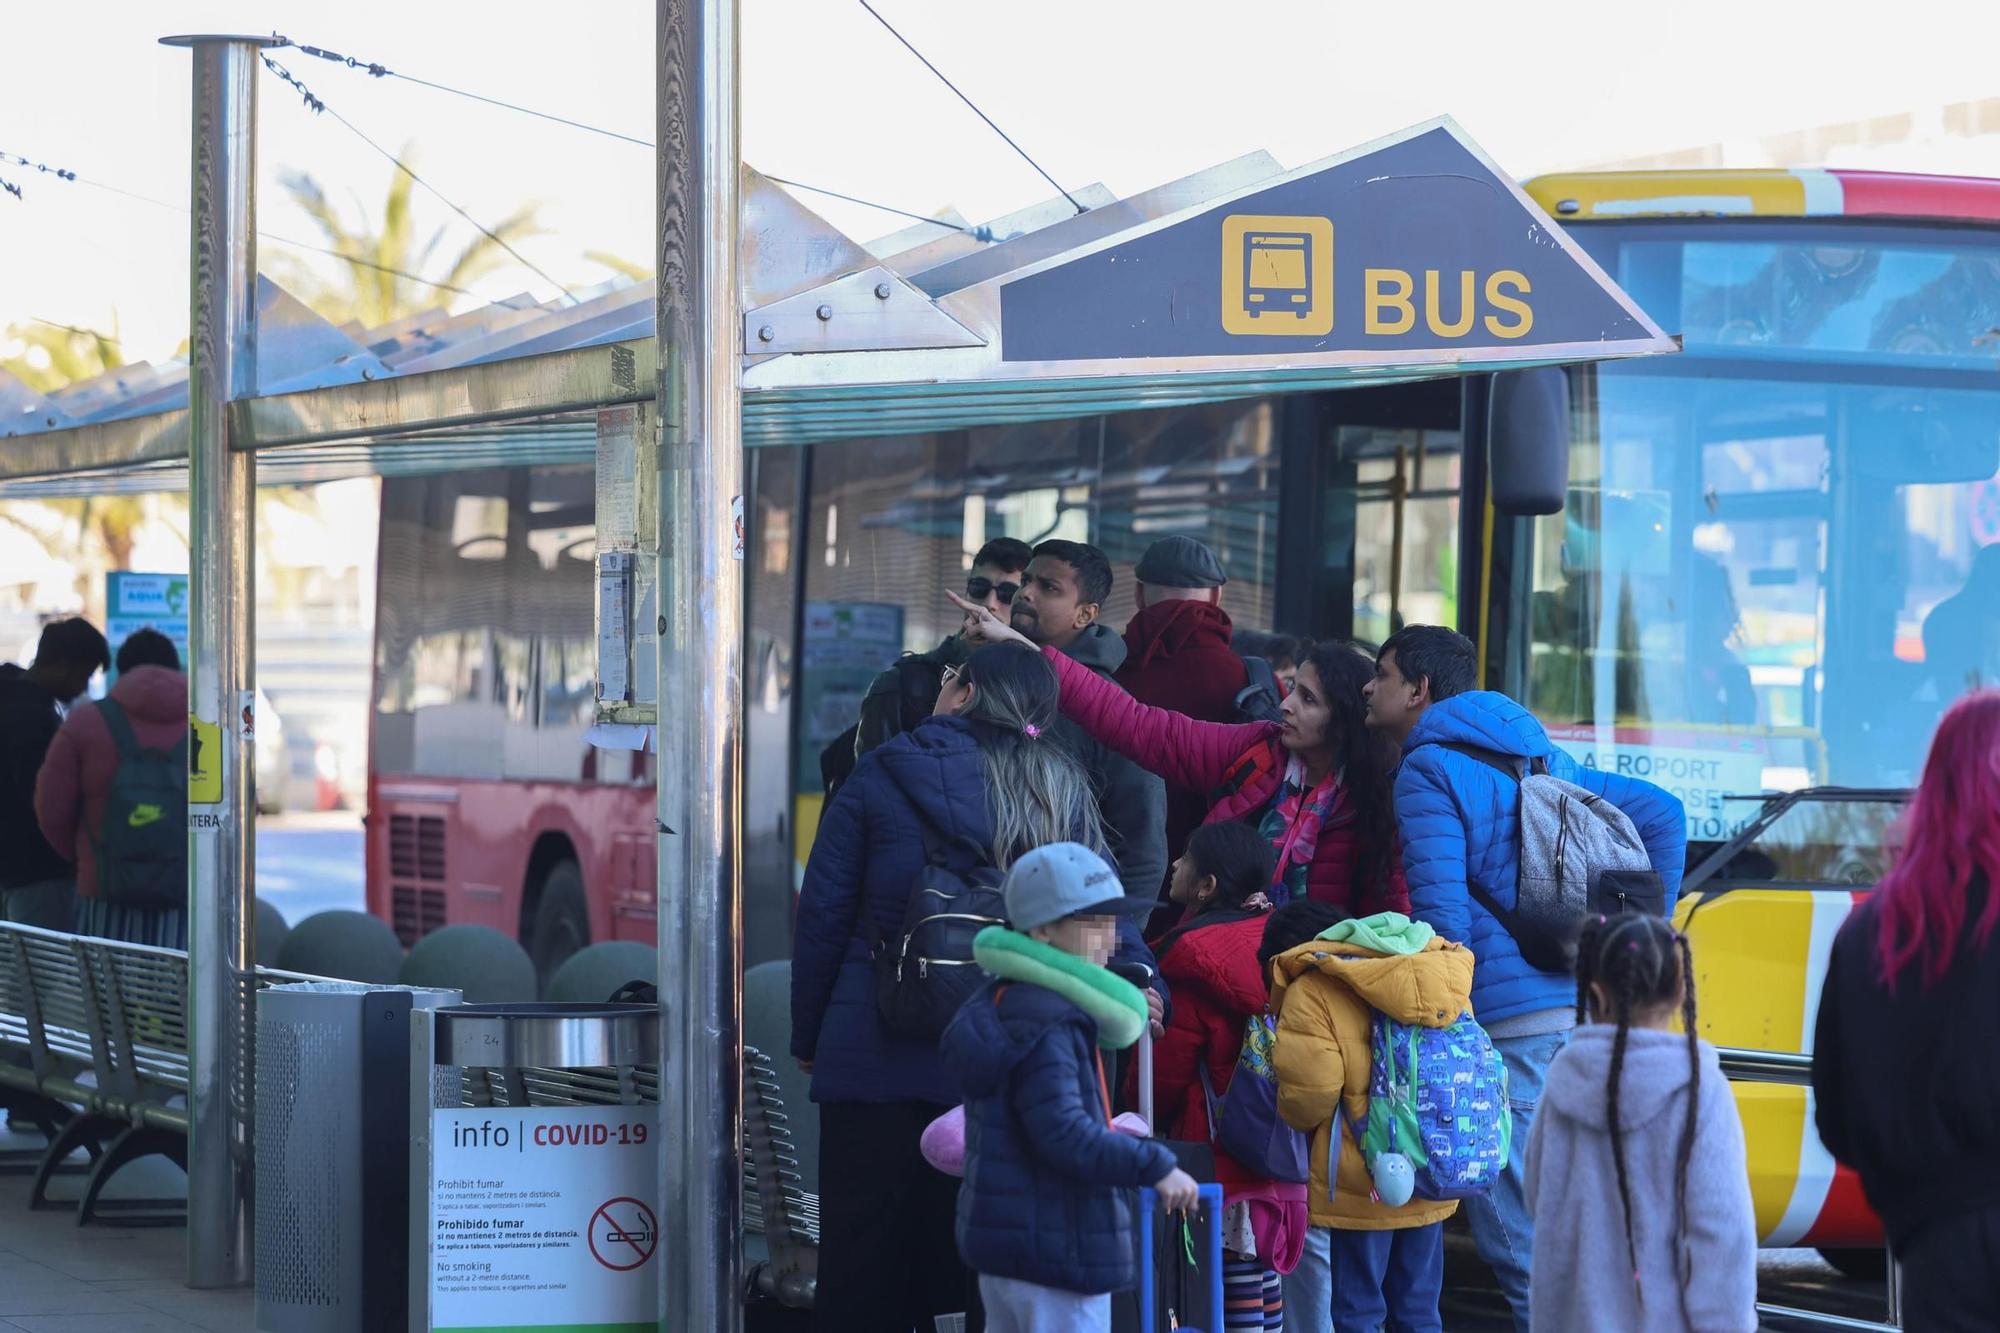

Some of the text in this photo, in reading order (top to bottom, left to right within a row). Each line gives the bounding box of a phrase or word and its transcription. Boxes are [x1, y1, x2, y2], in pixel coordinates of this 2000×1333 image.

[1364, 268, 1534, 338] BUS
[454, 1120, 648, 1147] info COVID-19
[438, 1179, 504, 1190] Prohibit fumar
[520, 1191, 528, 1199] de
[438, 1219, 524, 1229] Prohibido fumar
[532, 1231, 542, 1239] de
[543, 1230, 580, 1239] distancia.
[494, 1242, 536, 1250] vaporizadores
[437, 1262, 492, 1272] No smoking
